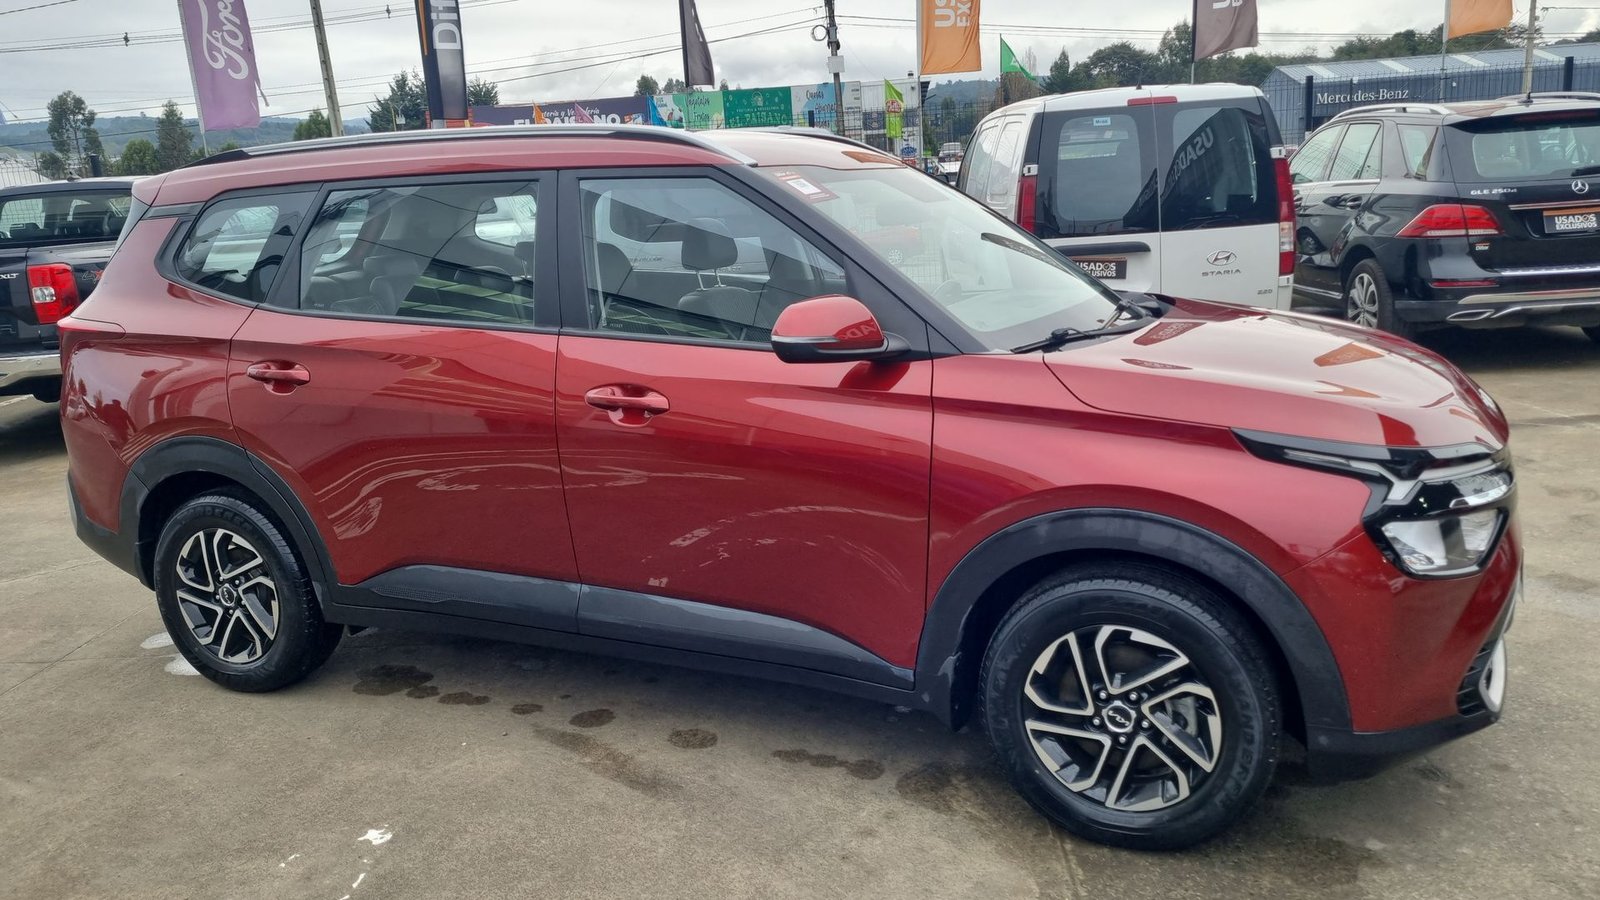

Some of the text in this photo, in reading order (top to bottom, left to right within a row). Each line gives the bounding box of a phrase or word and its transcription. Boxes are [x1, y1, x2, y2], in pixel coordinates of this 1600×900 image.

[957, 0, 972, 27] EX
[197, 0, 249, 80] For
[1316, 89, 1409, 105] Mercedes-Benz
[542, 113, 621, 125] PAISNO
[1554, 213, 1597, 224] USADOS
[1556, 221, 1598, 231] EXCLUSIVOS
[1202, 268, 1241, 277] STARIA
